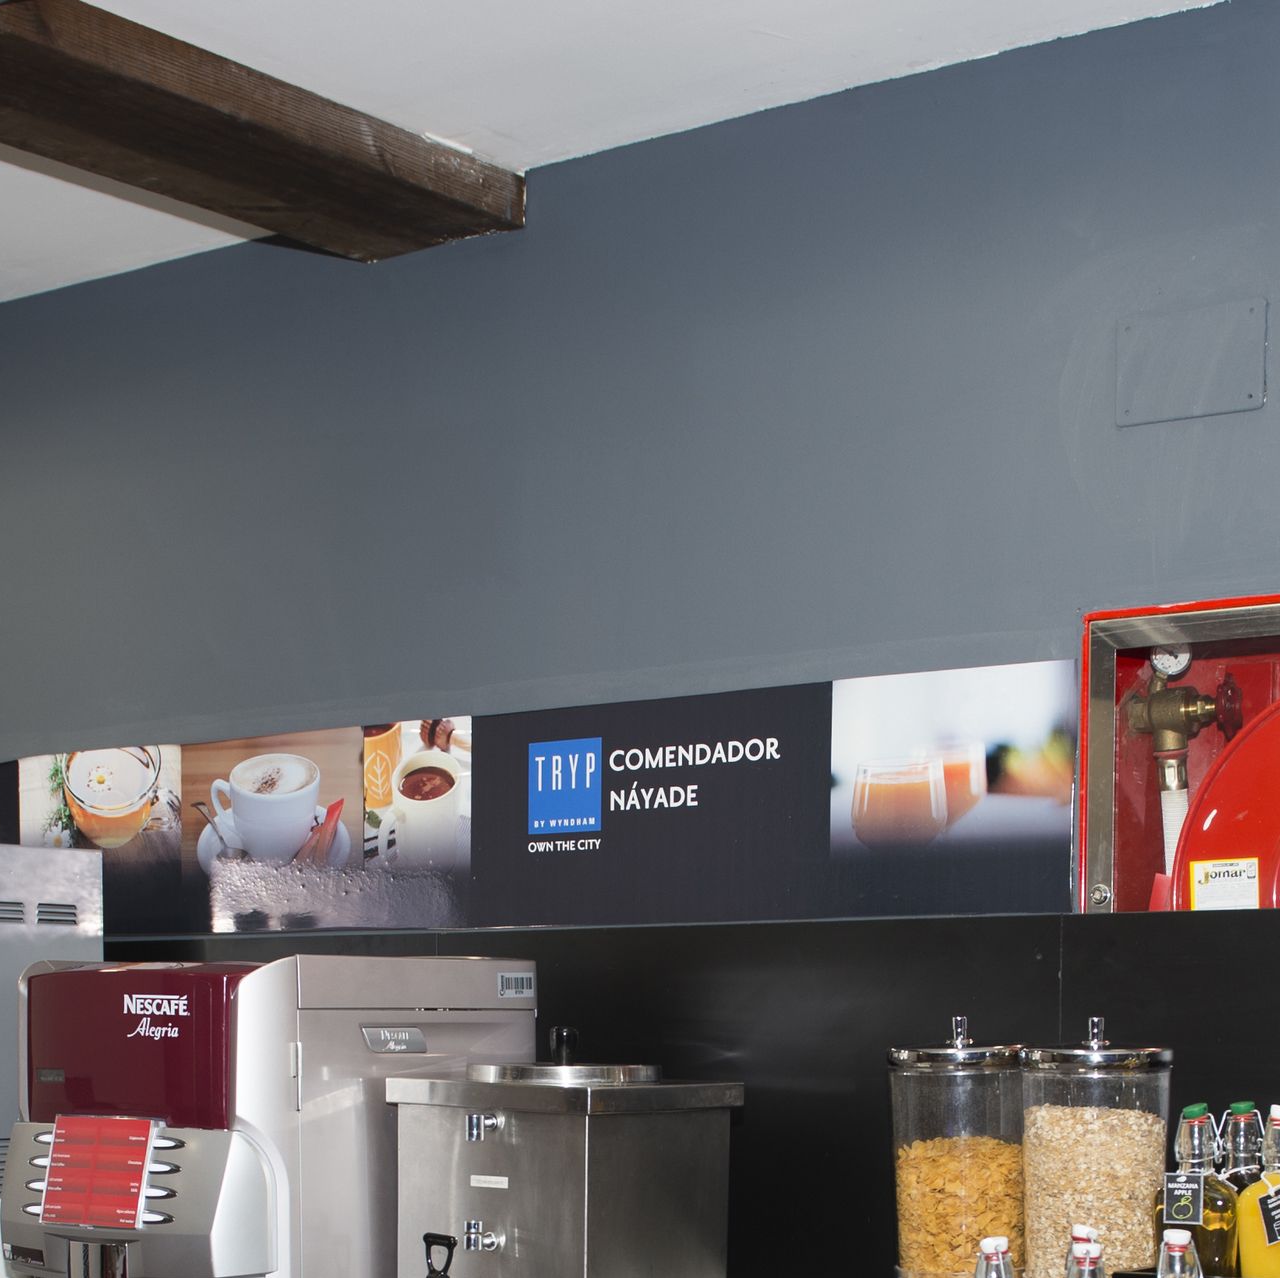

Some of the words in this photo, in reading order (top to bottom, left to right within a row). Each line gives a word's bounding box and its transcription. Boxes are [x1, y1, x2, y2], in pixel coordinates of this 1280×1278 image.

[608, 737, 780, 772] COMENDADOR
[535, 752, 596, 792] TRYP
[609, 781, 699, 811] NÁYADE
[534, 819, 545, 829] BY
[549, 816, 596, 828] WYNDHAM
[528, 841, 553, 853] OWN
[555, 839, 576, 851] THE
[577, 838, 601, 851] CITY
[123, 994, 189, 1016] NESCAFÉ
[127, 1017, 179, 1040] Alegria
